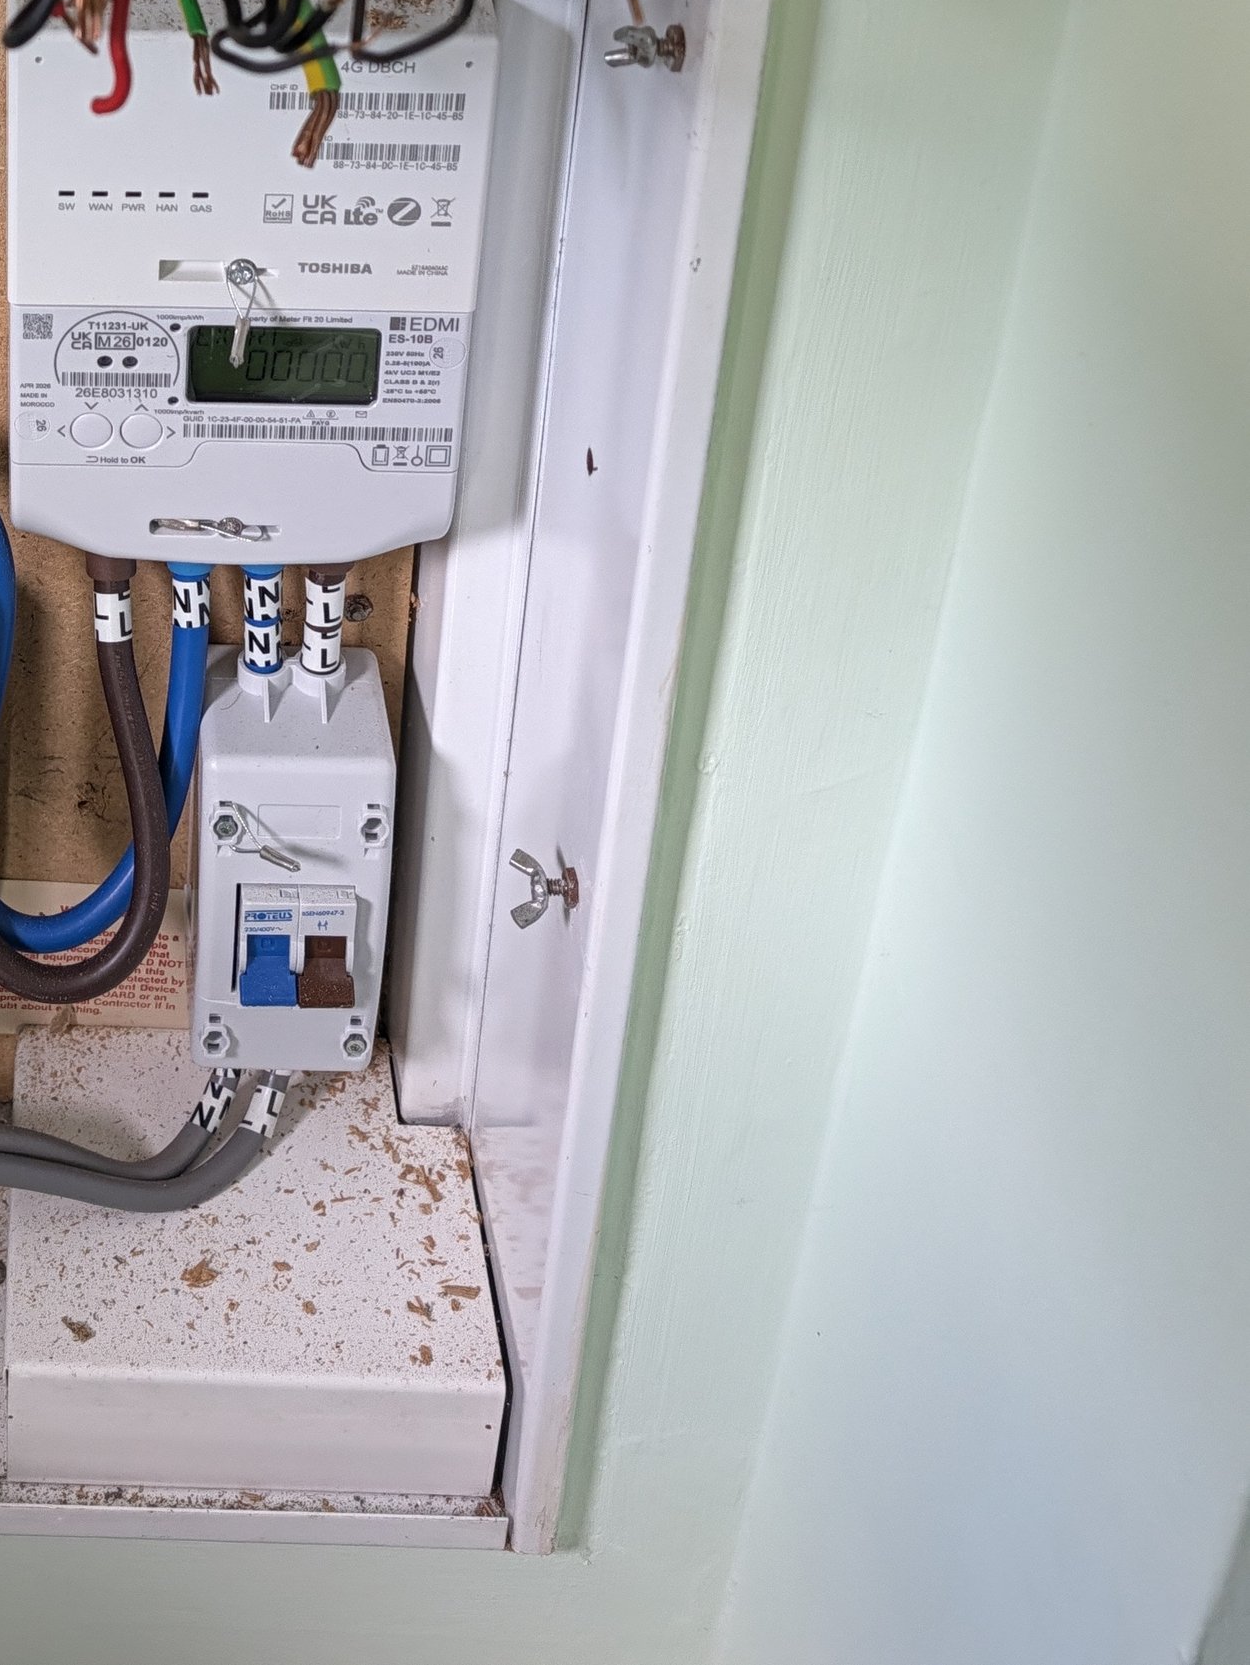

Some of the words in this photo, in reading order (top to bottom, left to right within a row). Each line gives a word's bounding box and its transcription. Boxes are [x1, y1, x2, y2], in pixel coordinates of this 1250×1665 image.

[340, 62, 363, 73] 4G
[369, 62, 416, 73] DBCH
[302, 194, 338, 209] UK
[58, 203, 75, 211] SW
[88, 203, 113, 211] WAN
[121, 203, 146, 212] PWR
[155, 204, 178, 212] HAN
[190, 204, 213, 213] GAS
[301, 210, 337, 225] CA
[298, 262, 373, 275] TOSHIBA
[87, 321, 149, 331] T11231-UK
[410, 317, 460, 332] EDMI
[71, 331, 92, 341] UK
[388, 334, 433, 344] ES-10B
[136, 337, 168, 347] 0120
[432, 346, 444, 359] 26
[75, 387, 158, 398] 26E8031310
[100, 456, 119, 464] Hold
[130, 456, 146, 464] OK
[258, 581, 280, 608] N
[323, 602, 341, 624] L
[248, 629, 270, 654] N
[321, 648, 337, 669] L
[245, 910, 293, 921] PROTEUS
[149, 950, 170, 958] that
[158, 959, 184, 968] NOT
[145, 967, 165, 976] this
[126, 975, 168, 984] otected
[171, 976, 185, 987] by
[140, 984, 179, 994] Device.
[21, 1003, 52, 1011] about
[94, 998, 151, 1008] Contractor
[165, 1002, 176, 1010] in
[266, 1090, 278, 1118] L
